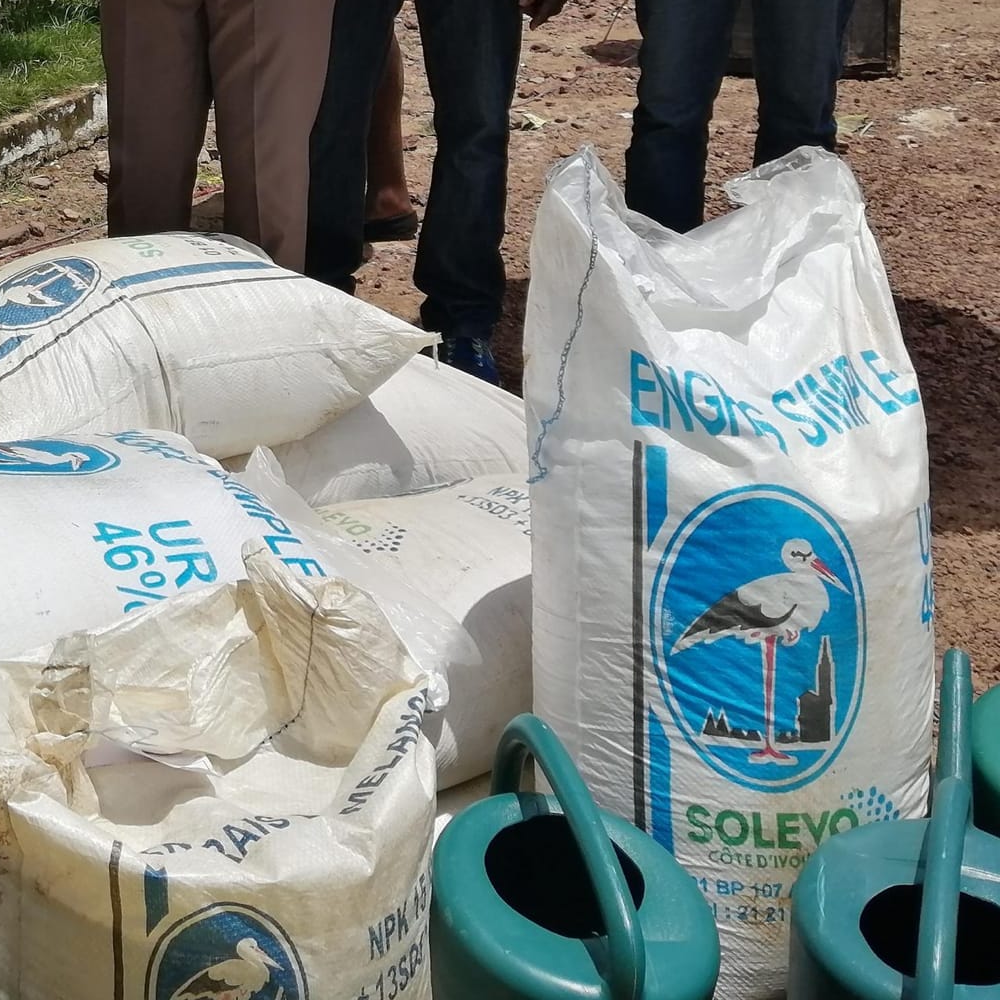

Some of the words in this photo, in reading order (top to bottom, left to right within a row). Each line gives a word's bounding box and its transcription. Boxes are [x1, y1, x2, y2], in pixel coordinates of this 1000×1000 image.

[148, 519, 218, 589] UR
[685, 803, 860, 849] SOLEVO
[708, 846, 754, 868] CÔTE
[757, 852, 810, 869] D'IVO
[716, 879, 745, 896] BP
[750, 882, 783, 898] 107
[368, 900, 409, 960] NPK
